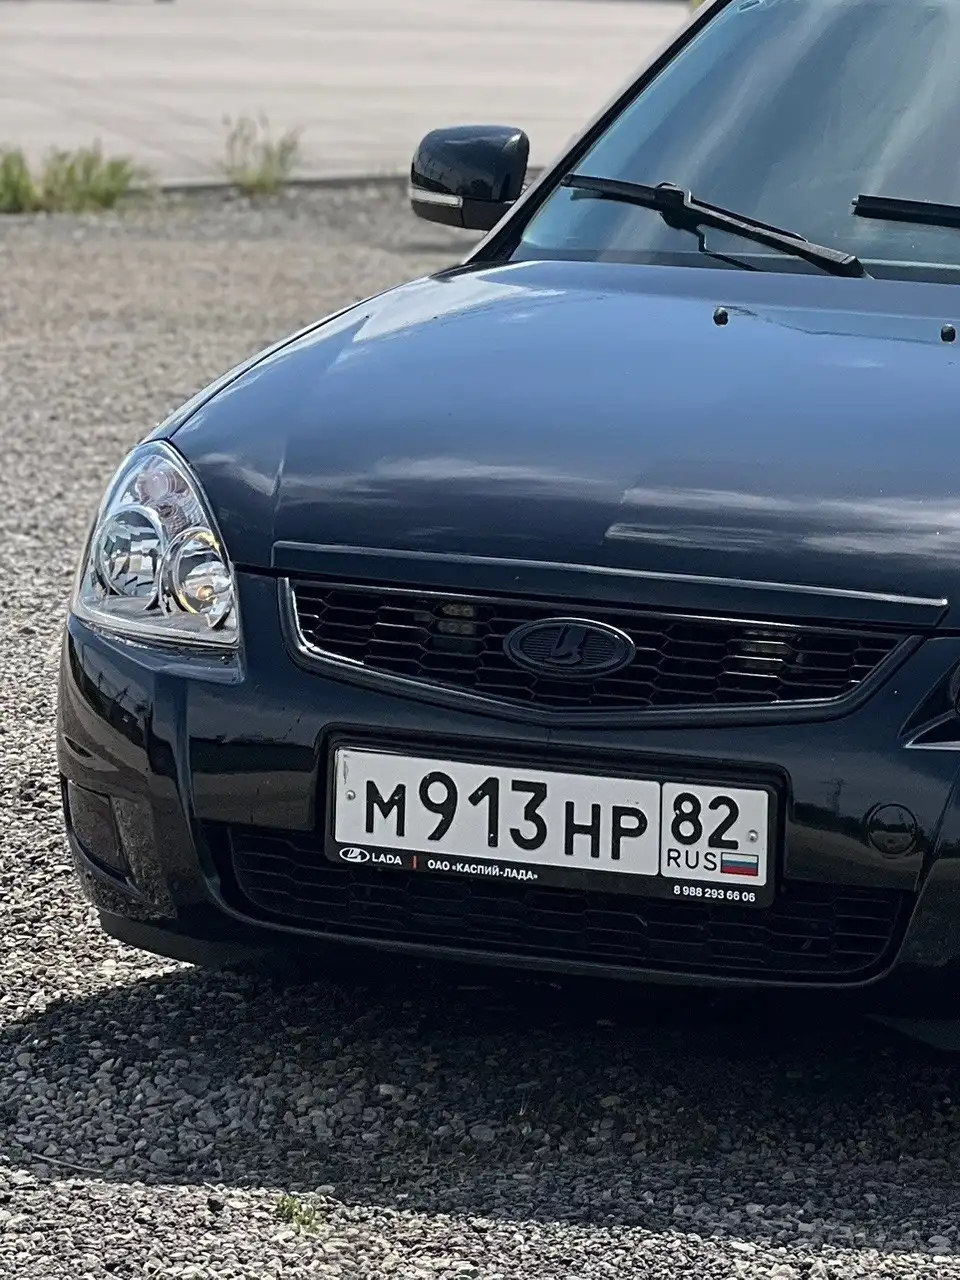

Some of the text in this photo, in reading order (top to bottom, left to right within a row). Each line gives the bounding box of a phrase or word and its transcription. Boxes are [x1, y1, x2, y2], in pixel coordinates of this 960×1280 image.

[671, 792, 739, 850] 82
[371, 852, 402, 866] LADA
[427, 859, 450, 871] ОАО
[667, 849, 718, 872] RUS
[673, 885, 756, 902] 8 988 293 66 06
